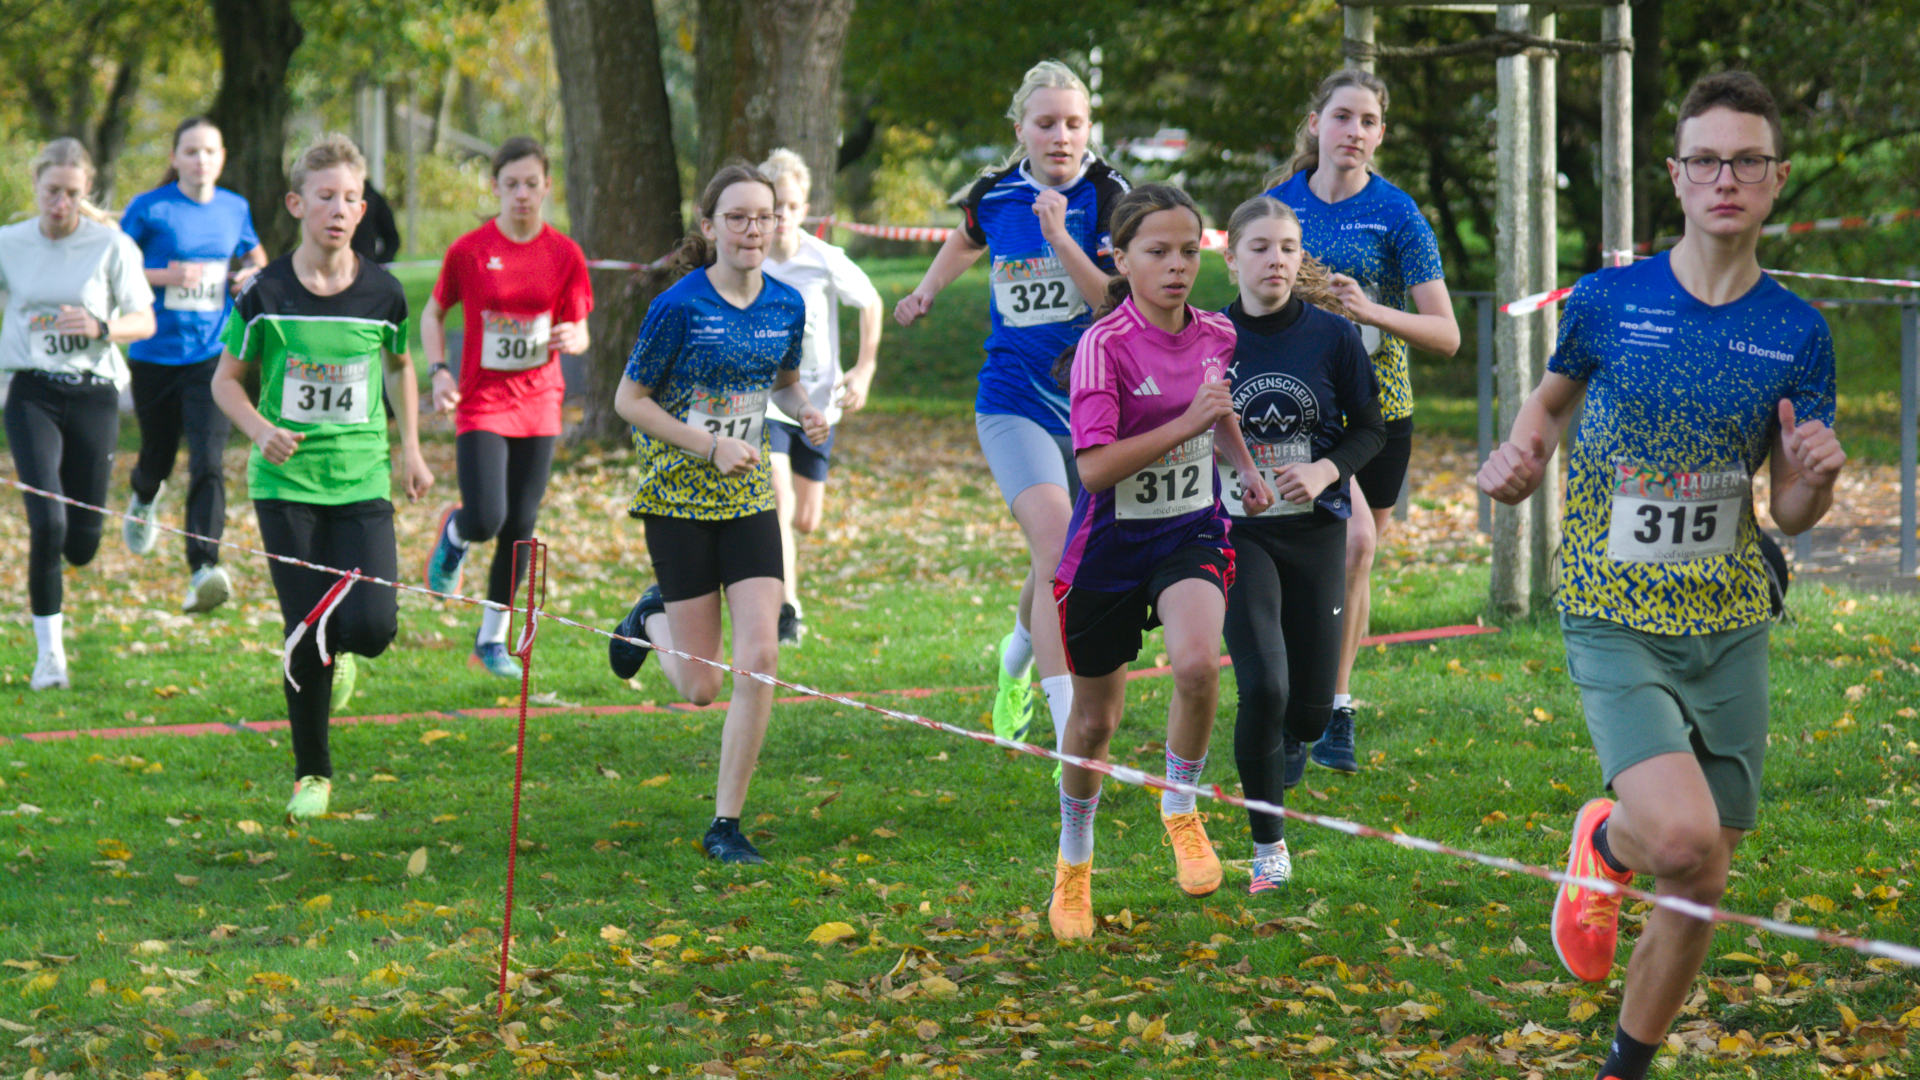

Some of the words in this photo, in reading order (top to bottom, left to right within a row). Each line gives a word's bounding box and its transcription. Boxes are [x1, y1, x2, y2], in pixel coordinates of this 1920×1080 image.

[1010, 280, 1069, 313] 322
[43, 333, 89, 356] 300
[495, 336, 538, 360] 301
[1728, 339, 1746, 352] LG
[1748, 343, 1794, 363] Dorsten
[297, 384, 354, 412] 314
[1232, 376, 1314, 410] WATTENSCHEID
[1257, 442, 1305, 458] LAUFEN
[1135, 464, 1200, 504] 312
[1680, 472, 1741, 489] LAUFEN
[1633, 503, 1718, 544] 315
